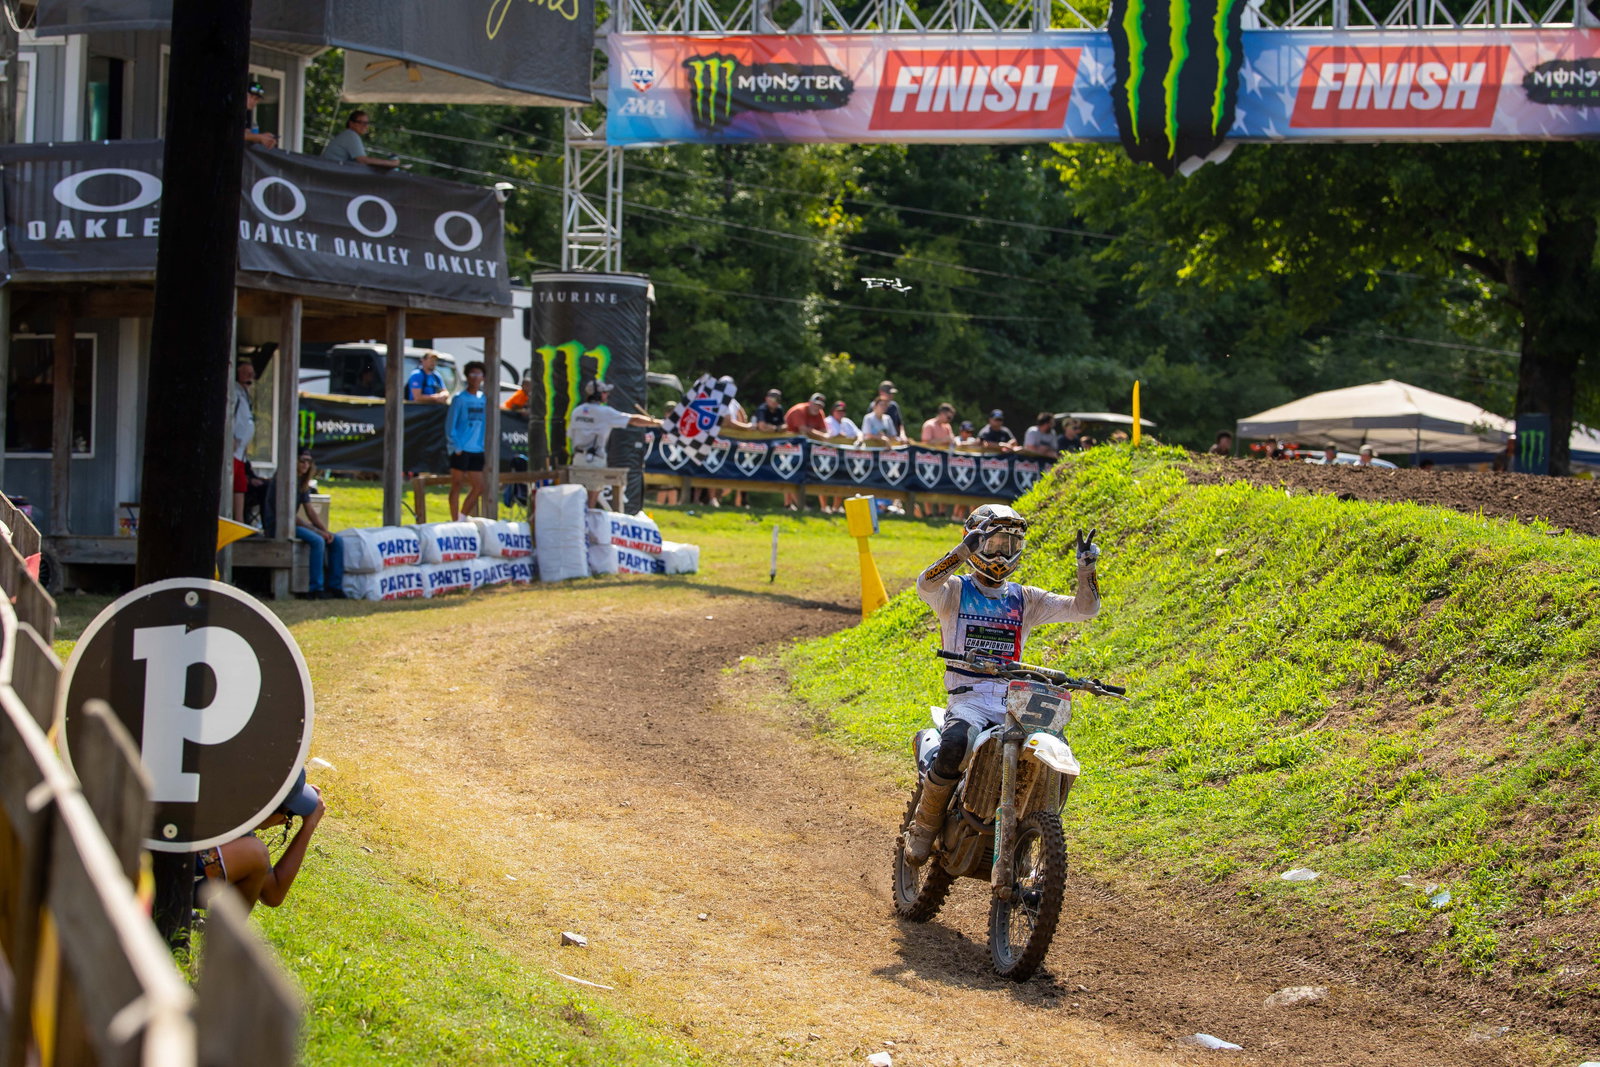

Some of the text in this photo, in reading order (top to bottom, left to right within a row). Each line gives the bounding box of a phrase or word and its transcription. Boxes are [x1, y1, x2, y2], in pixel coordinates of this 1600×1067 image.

[738, 72, 845, 93] MONSTER
[1311, 62, 1487, 111] FINISH
[1534, 67, 1600, 88] MONS
[755, 94, 829, 103] ENERGY
[889, 65, 1059, 112] FINISH
[1551, 89, 1600, 98] ENER
[617, 97, 668, 118] AMA
[28, 217, 160, 241] OAKLE
[240, 219, 499, 279] OAKLEY OAKLEY OAKLEY
[539, 291, 618, 305] TAURINE
[498, 533, 532, 549] PARTS
[611, 521, 662, 545] PARTS
[378, 539, 420, 558] PARTS
[437, 536, 477, 552] PARTS
[511, 563, 536, 580] PAR
[618, 551, 659, 571] PARTS
[925, 554, 959, 580] ROCKSTAR
[380, 573, 423, 594] PARTS
[428, 567, 471, 588] PARTS
[966, 638, 1014, 650] CHAMPIONSHIP
[1020, 692, 1062, 727] 5
